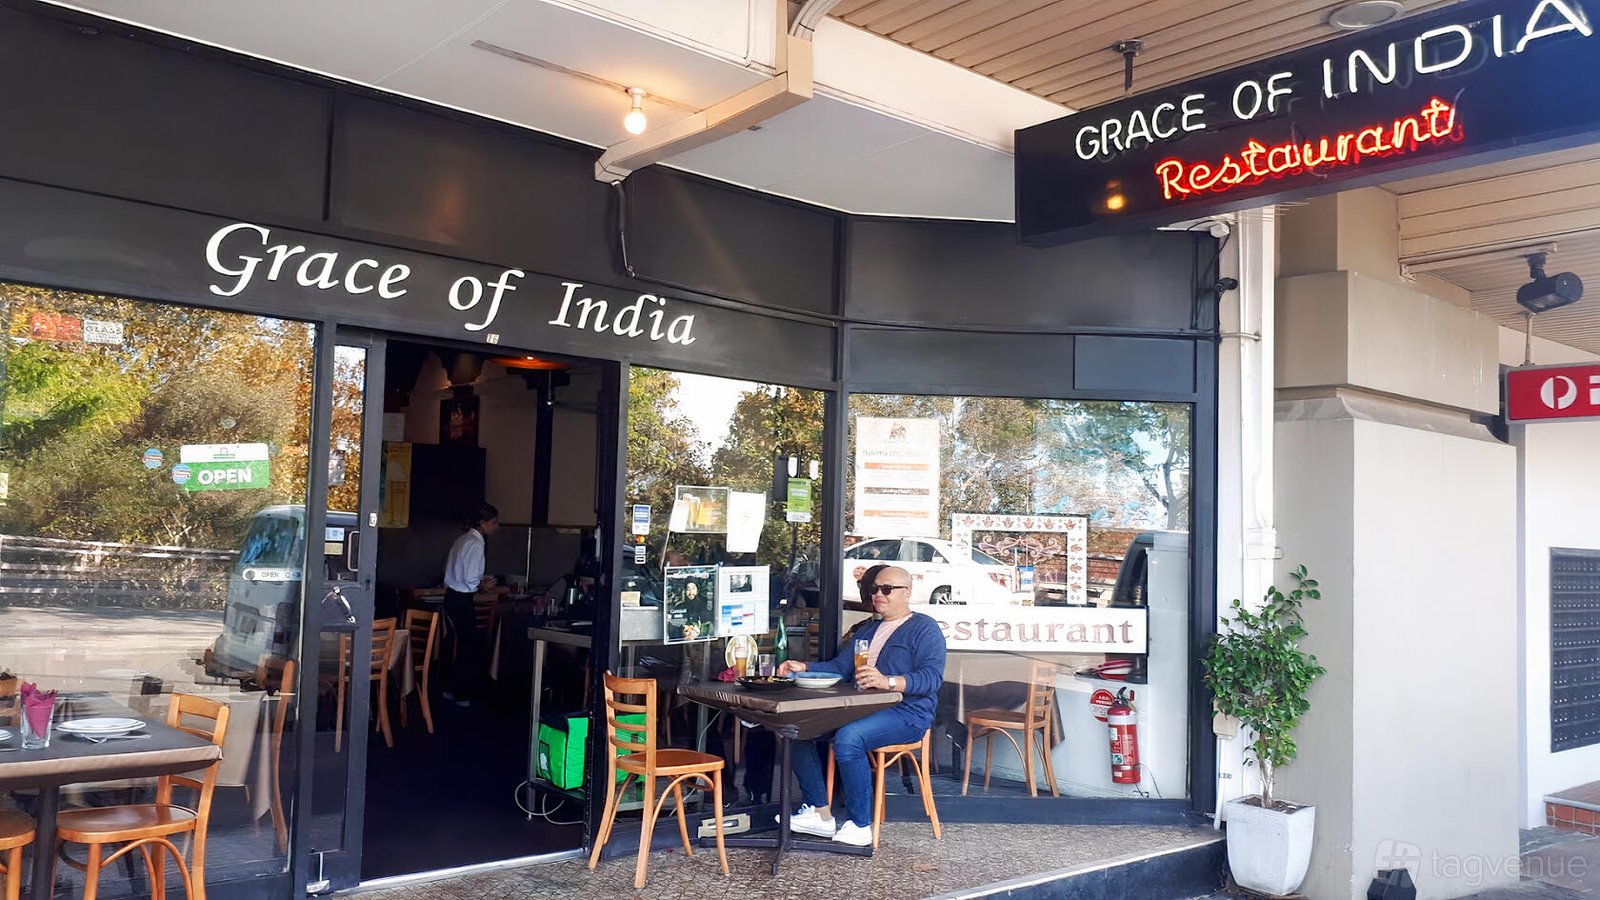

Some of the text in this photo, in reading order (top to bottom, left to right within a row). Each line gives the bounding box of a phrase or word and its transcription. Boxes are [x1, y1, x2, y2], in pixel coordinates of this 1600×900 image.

[1075, 0, 1592, 161] GRACE OF INDIA
[1156, 96, 1460, 200] Restaurant
[205, 222, 697, 347] Grace of India
[197, 467, 253, 485] OPEN
[936, 616, 1134, 644] estaurant
